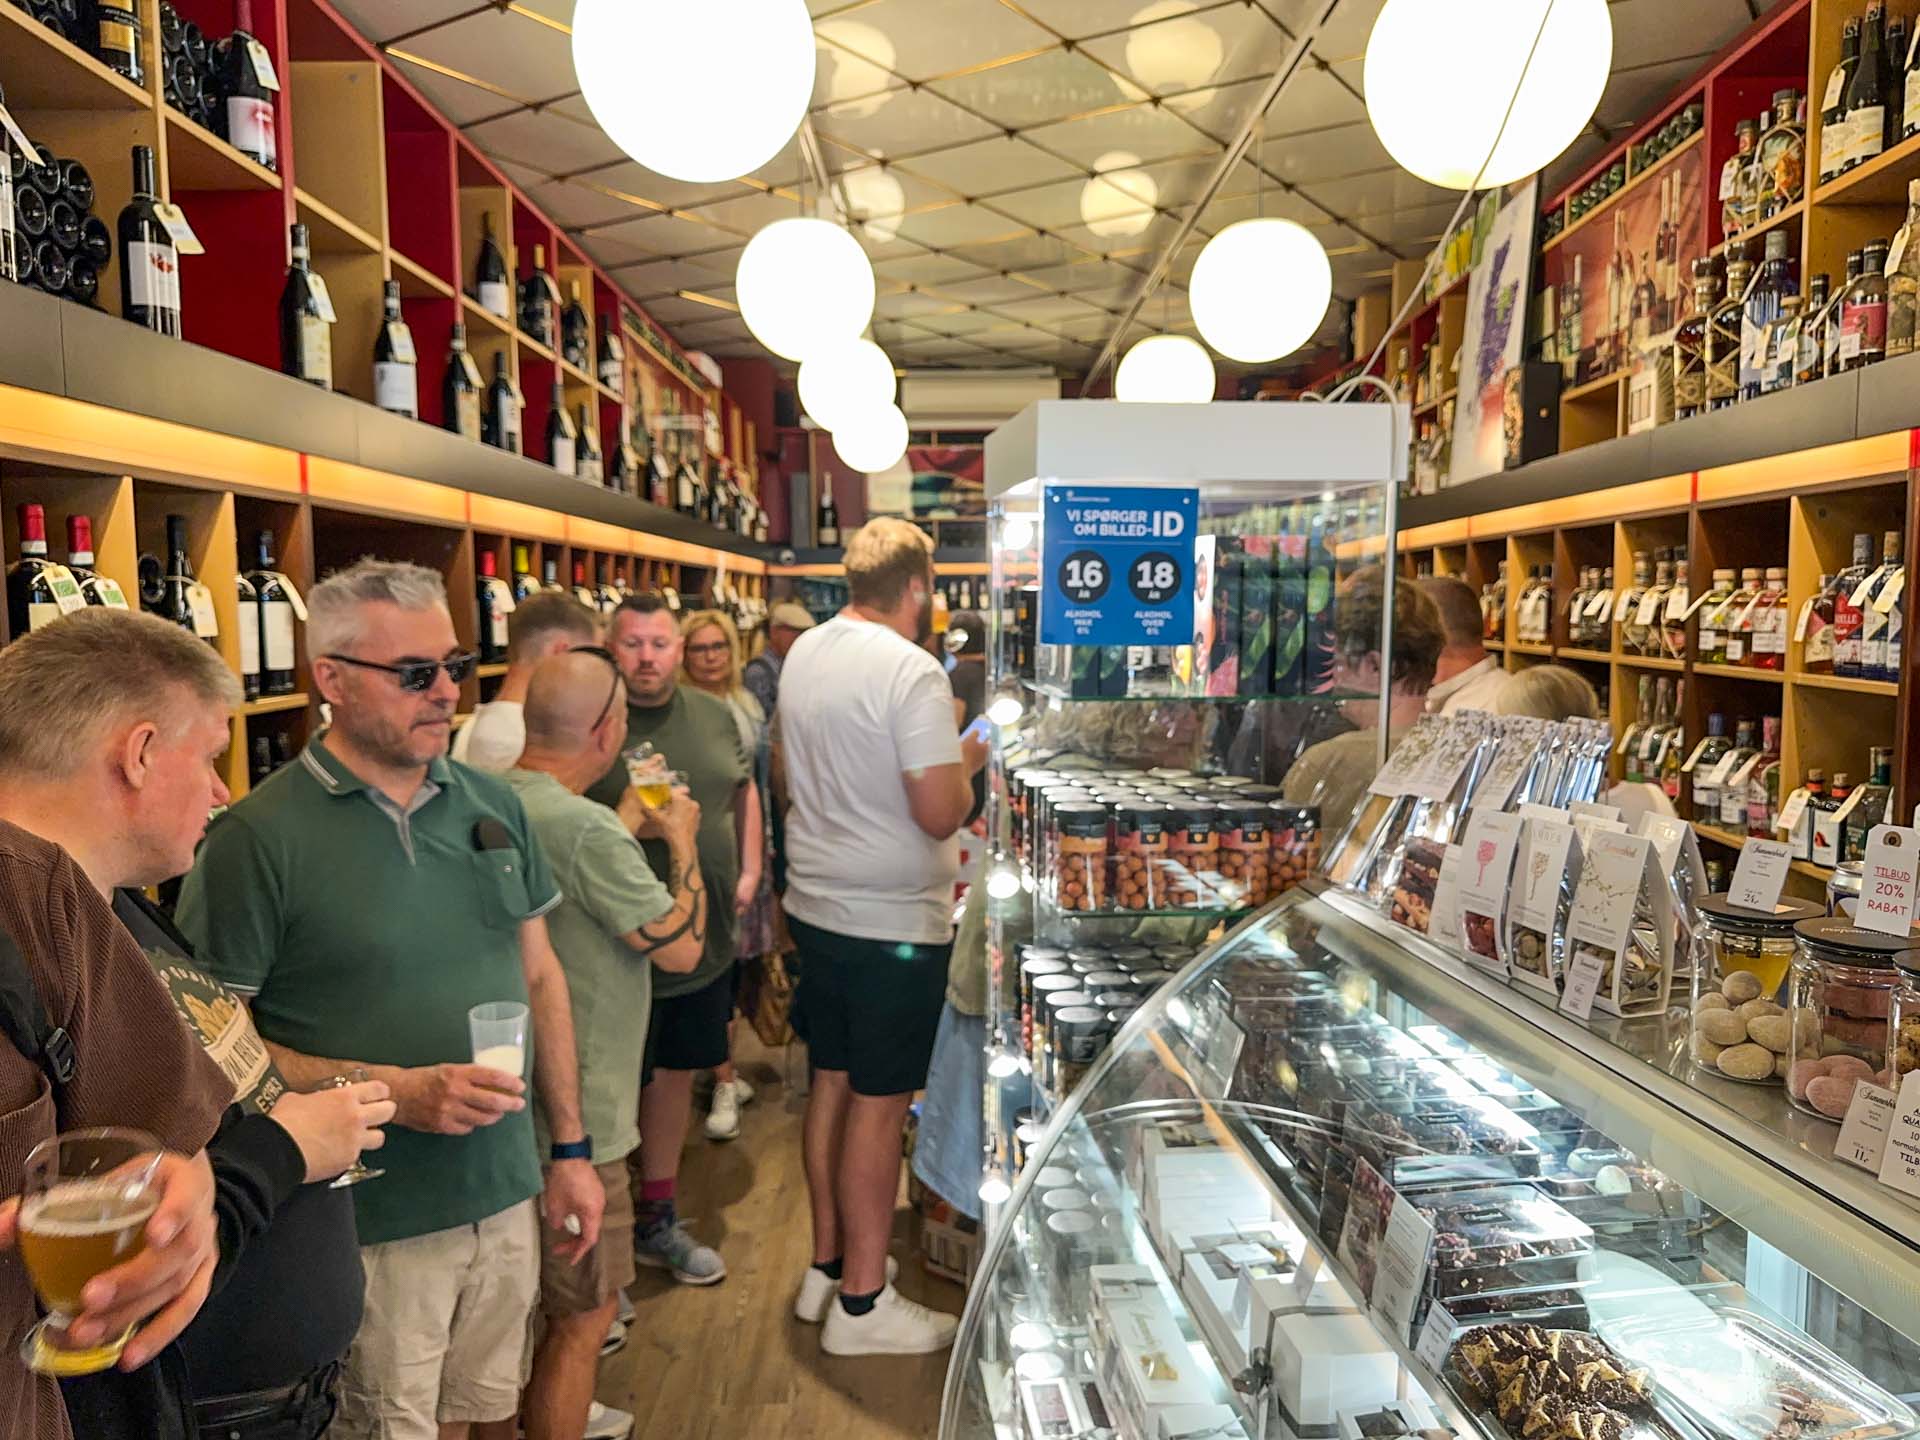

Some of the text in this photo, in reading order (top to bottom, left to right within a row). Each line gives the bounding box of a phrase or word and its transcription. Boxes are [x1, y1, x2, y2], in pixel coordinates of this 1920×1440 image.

[1066, 510, 1147, 523] VI SPØRGER
[1073, 523, 1098, 536] OM
[1153, 511, 1184, 537] ID
[1066, 560, 1103, 588] 16
[1137, 561, 1174, 589] 18
[1874, 866, 1911, 881] TILBUD
[1875, 882, 1904, 898] 20%
[1867, 899, 1908, 916] RABAT
[1902, 1115, 1920, 1127] QUA
[1900, 1151, 1920, 1165] TILB
